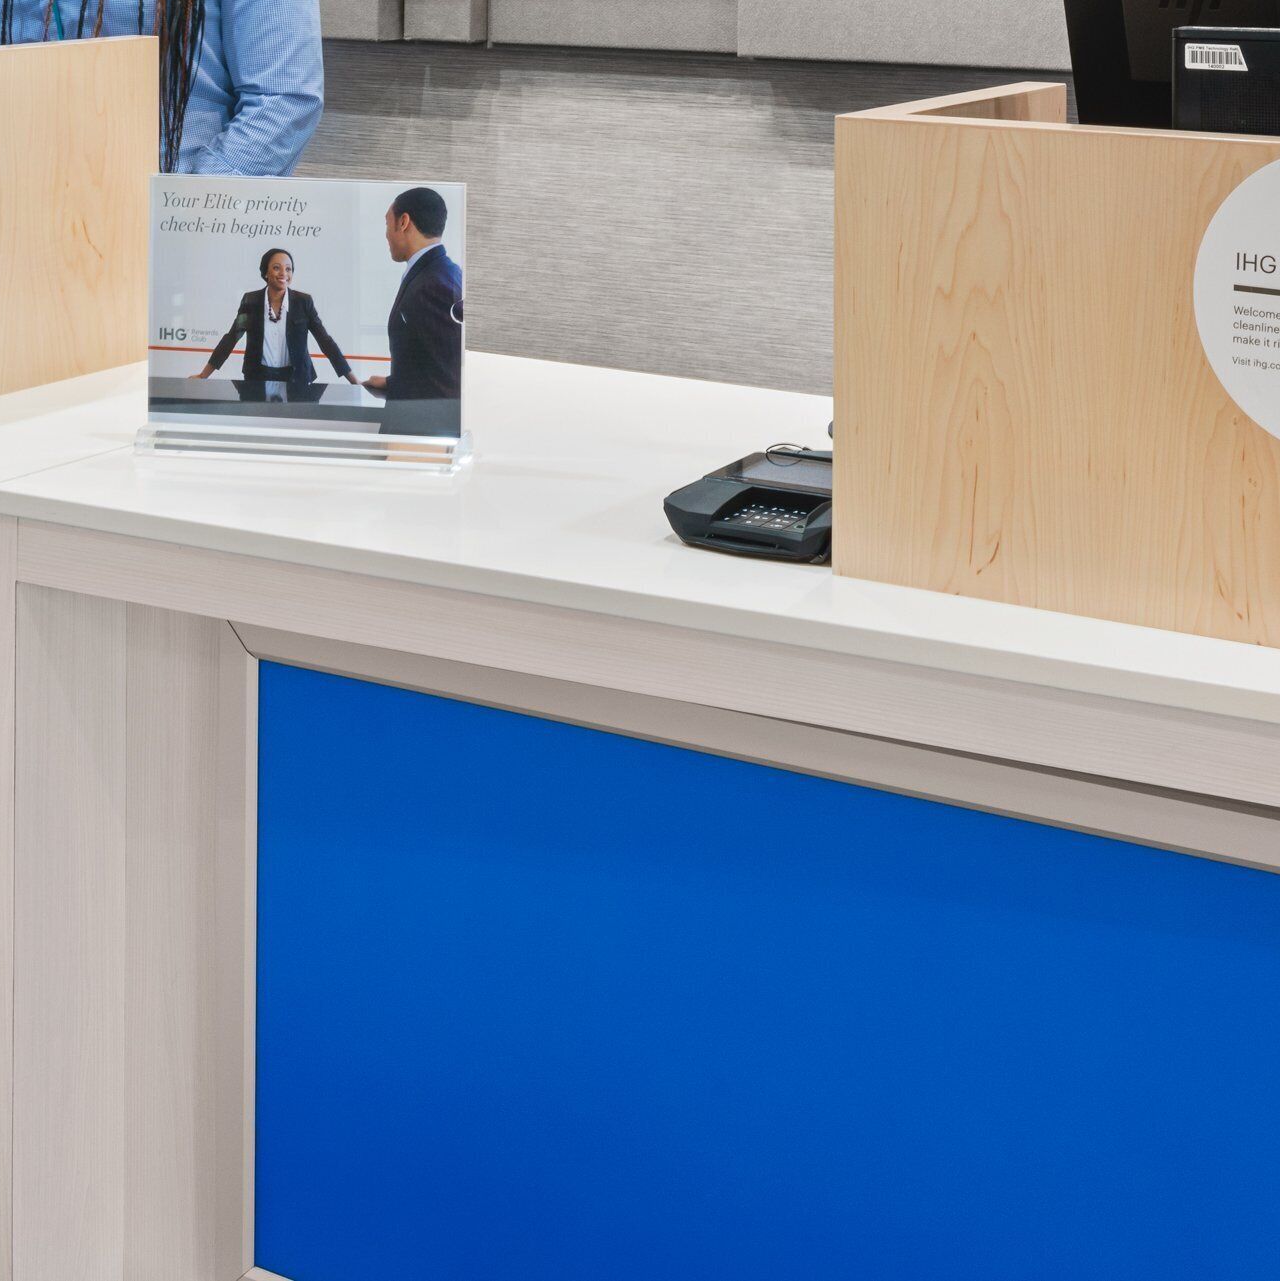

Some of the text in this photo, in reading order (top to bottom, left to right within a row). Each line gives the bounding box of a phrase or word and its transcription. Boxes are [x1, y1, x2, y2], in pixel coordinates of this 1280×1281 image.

[161, 192, 308, 216] Your Elite priority
[160, 216, 322, 239] check-in begins here
[1235, 252, 1277, 274] IHG
[159, 327, 187, 341] IHG
[1232, 335, 1261, 346] make
[1263, 338, 1270, 348] it
[1232, 356, 1251, 366] Visit
